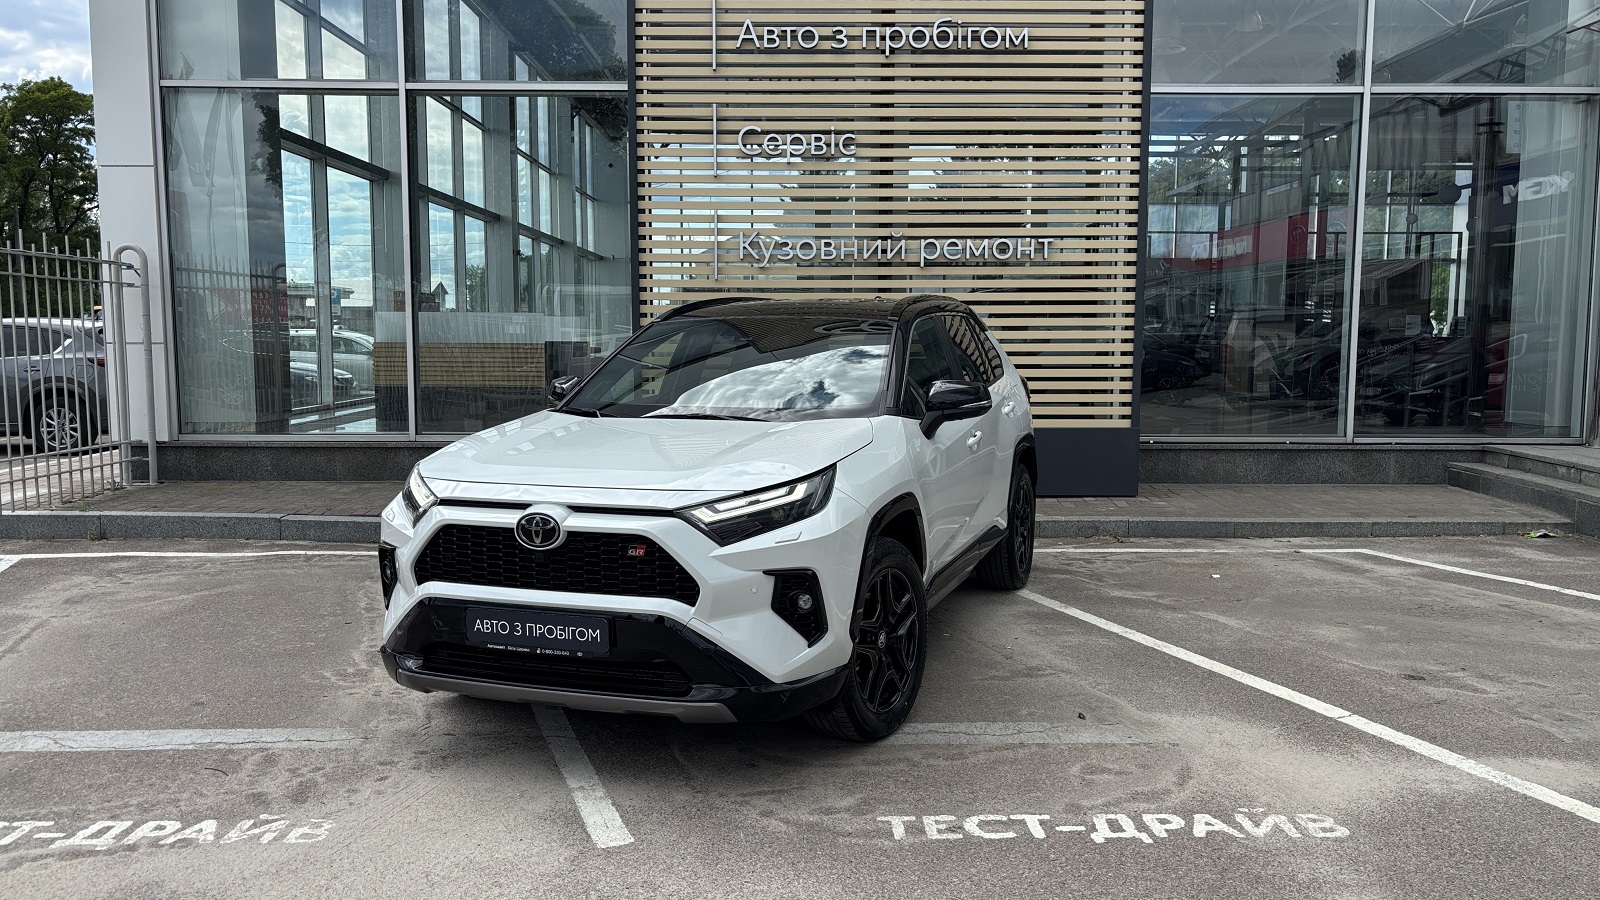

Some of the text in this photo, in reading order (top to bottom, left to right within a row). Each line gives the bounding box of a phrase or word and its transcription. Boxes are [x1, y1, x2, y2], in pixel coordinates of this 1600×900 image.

[736, 17, 1030, 58] Авто з пробігом
[737, 125, 857, 164] Сервіс
[738, 231, 1055, 269] Кузовний ремонт
[628, 547, 645, 556] GR
[473, 619, 601, 642] АВТО З ПРОБІГОМ
[0, 813, 336, 850] Т-ДРАЙВ
[877, 808, 1351, 843] ТЕСТ-ДРАЙВ
